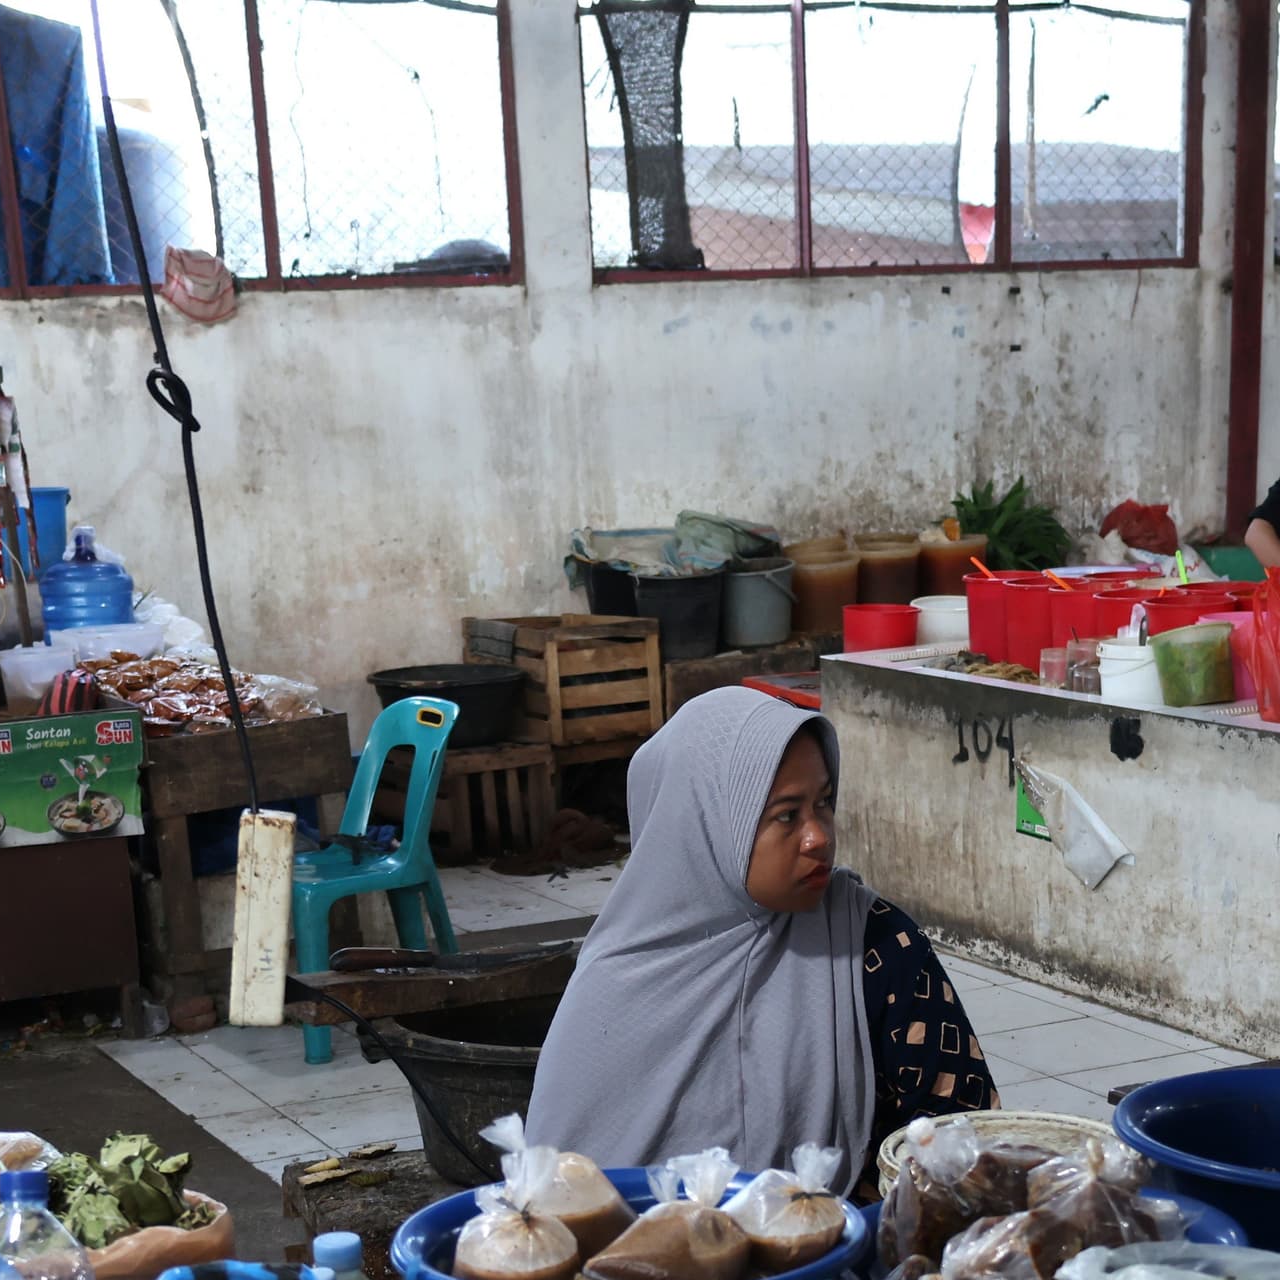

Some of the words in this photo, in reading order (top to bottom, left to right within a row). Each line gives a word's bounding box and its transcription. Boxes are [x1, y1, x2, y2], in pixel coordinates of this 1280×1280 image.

[25, 726, 71, 740] Santan
[96, 721, 134, 745] SUN
[952, 713, 1015, 788] 104
